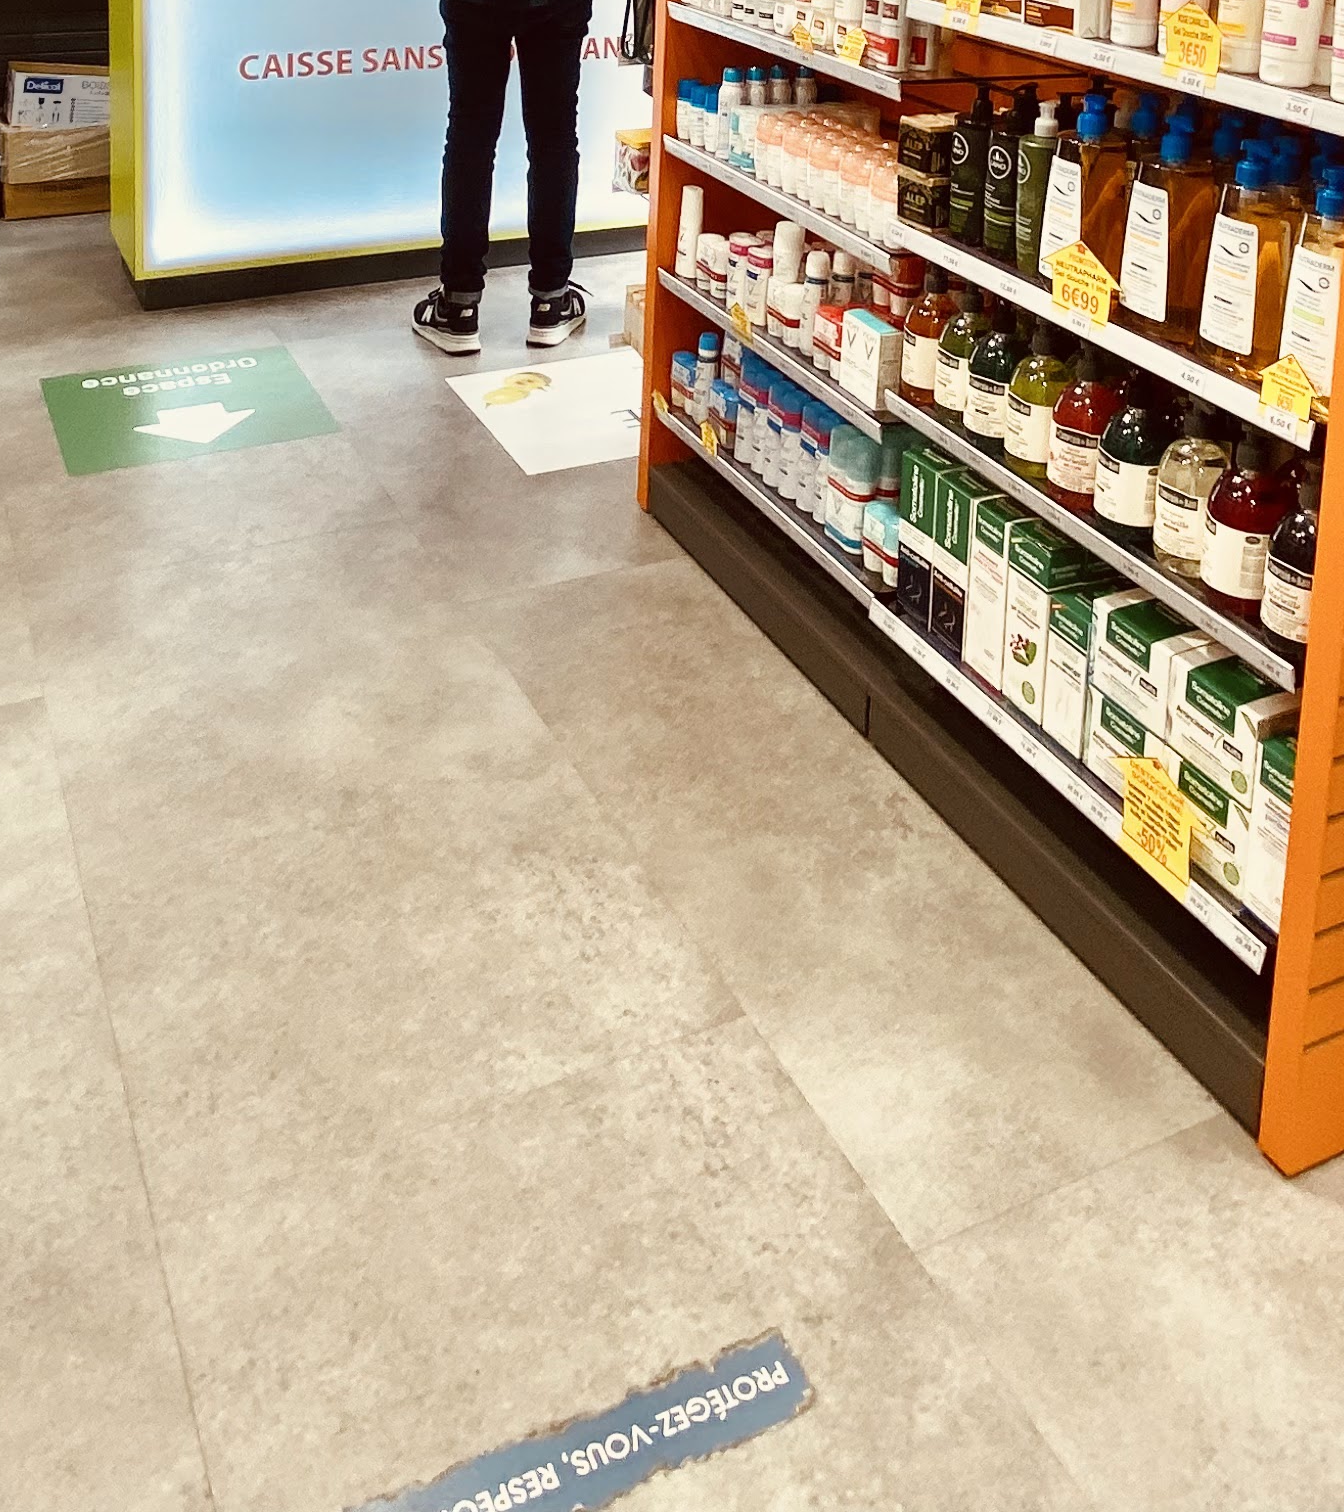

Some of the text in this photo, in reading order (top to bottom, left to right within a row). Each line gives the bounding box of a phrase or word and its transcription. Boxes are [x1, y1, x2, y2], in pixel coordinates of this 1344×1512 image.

[239, 45, 444, 81] CAISSE SANS
[1179, 40, 1207, 68] 3€50
[1061, 283, 1099, 315] 6€99
[81, 356, 258, 391] Ordonnance
[122, 374, 232, 398] Espace
[1136, 827, 1168, 866] -50%
[442, 1360, 790, 1512] PROTÉGEZ-VOUS, RESPEC
